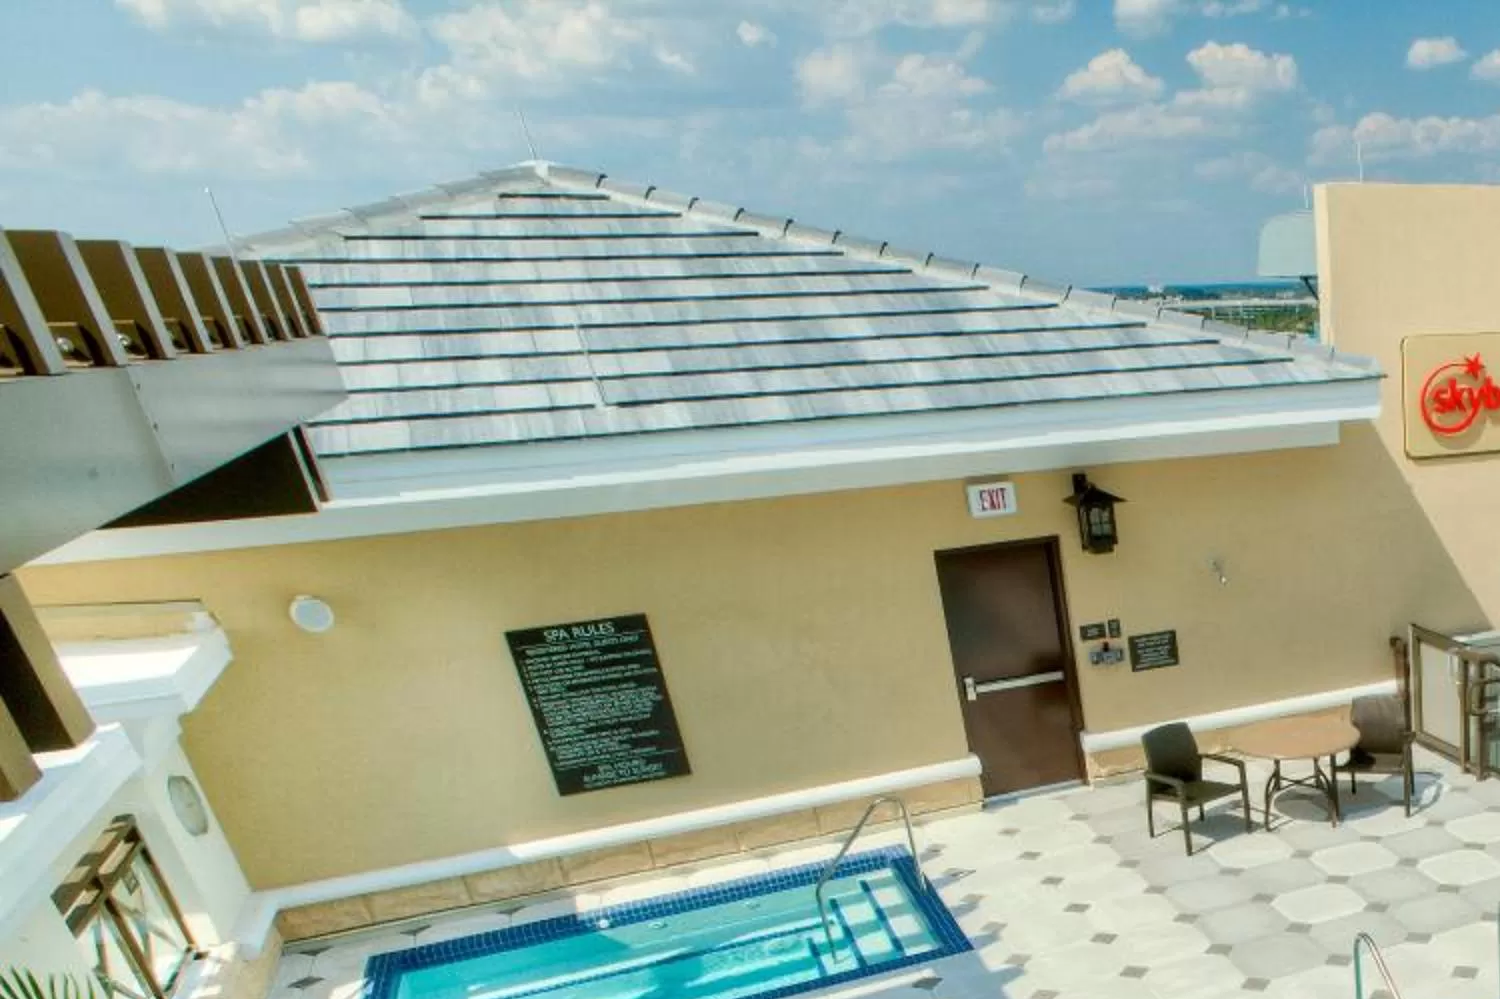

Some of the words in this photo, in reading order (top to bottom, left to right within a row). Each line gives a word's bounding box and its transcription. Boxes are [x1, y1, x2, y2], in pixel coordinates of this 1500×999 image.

[979, 487, 1007, 512] EXIT
[543, 628, 570, 642] SPA
[571, 621, 615, 637] RULES
